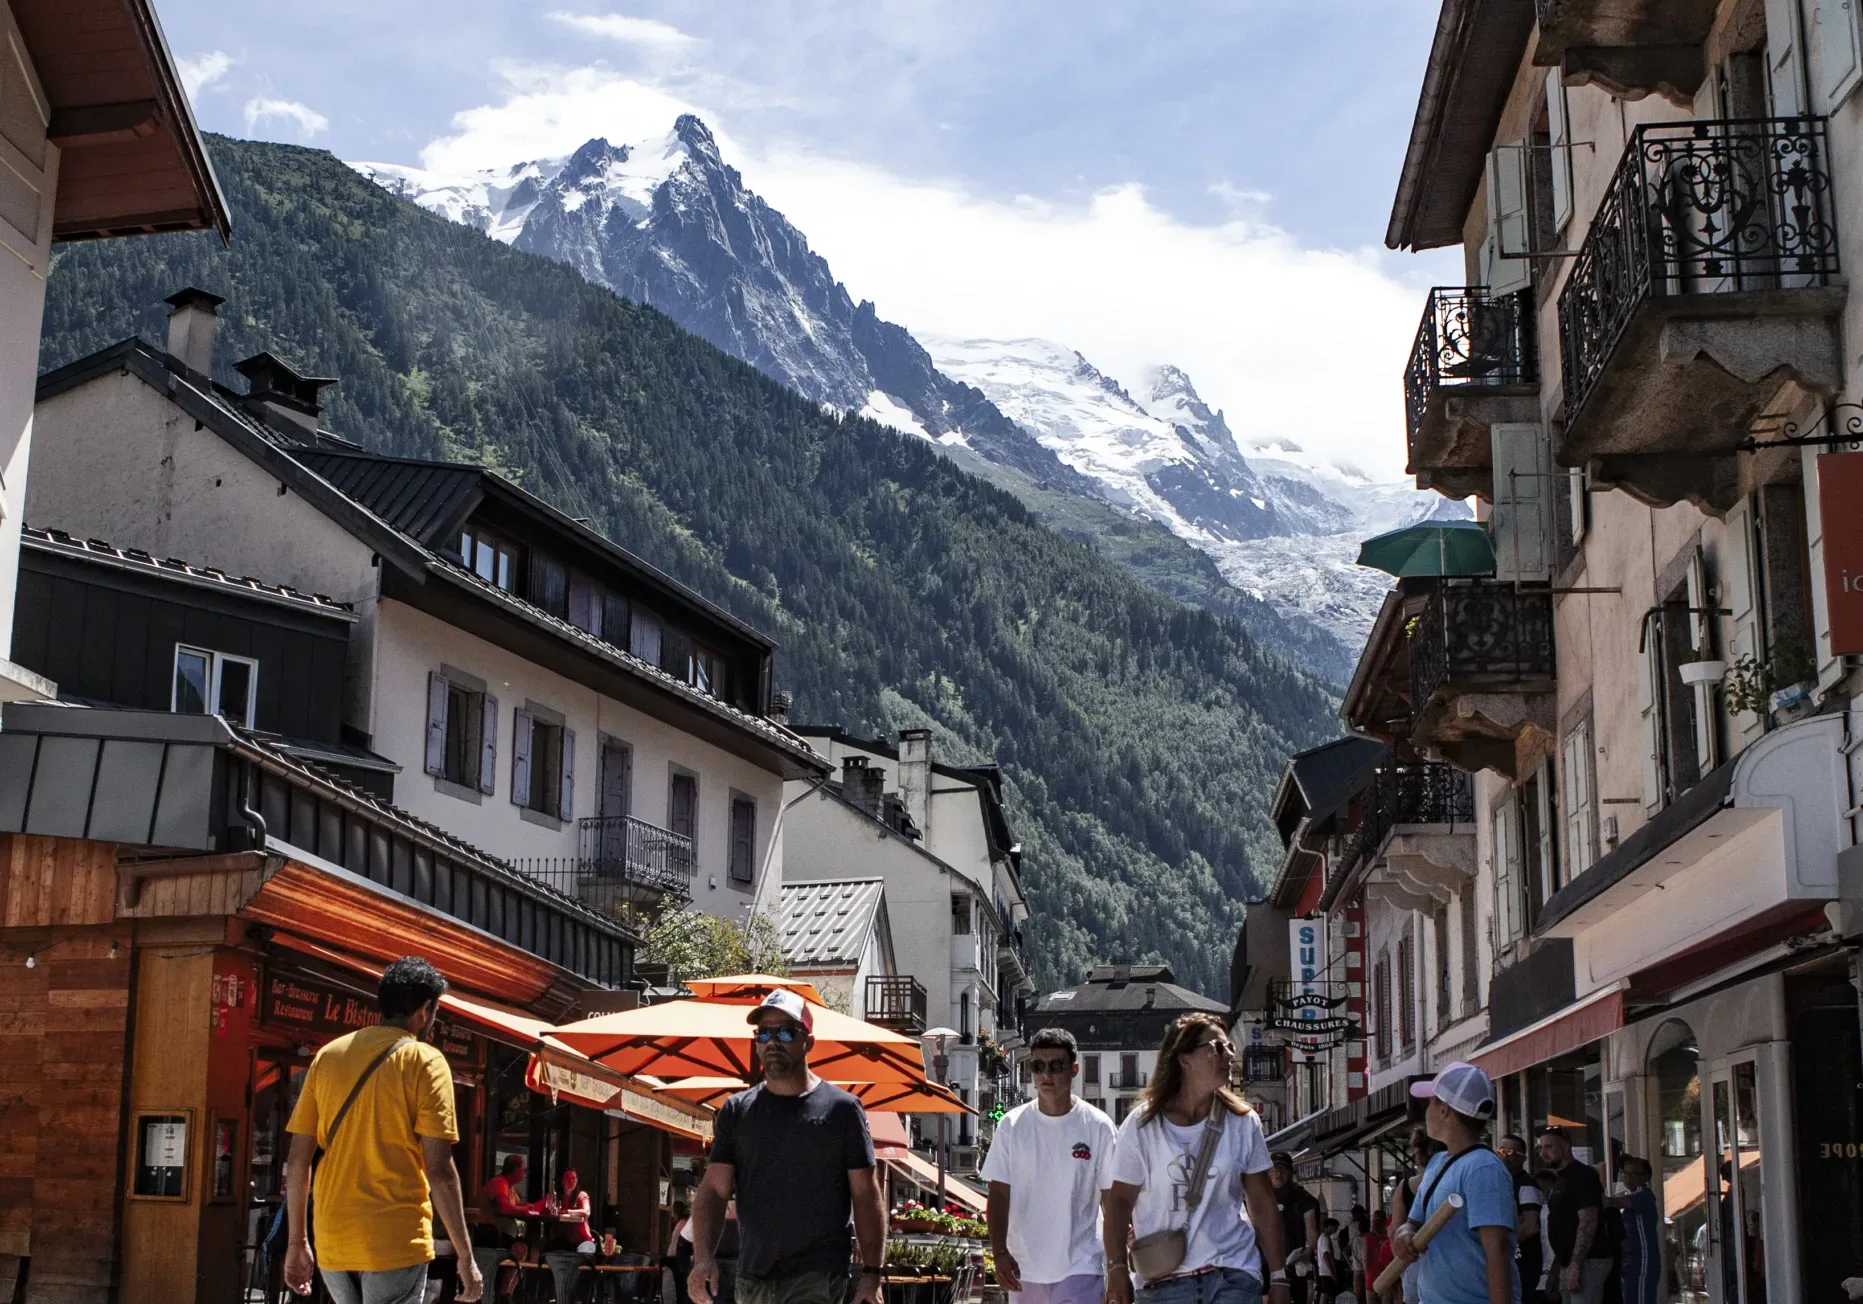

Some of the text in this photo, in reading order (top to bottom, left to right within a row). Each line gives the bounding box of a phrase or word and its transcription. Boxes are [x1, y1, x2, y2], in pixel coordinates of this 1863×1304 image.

[1292, 996, 1328, 1007] PAYOT
[324, 994, 341, 1022] Le
[1274, 1019, 1349, 1031] CHAUSSURES
[1290, 1041, 1315, 1051] Depuis
